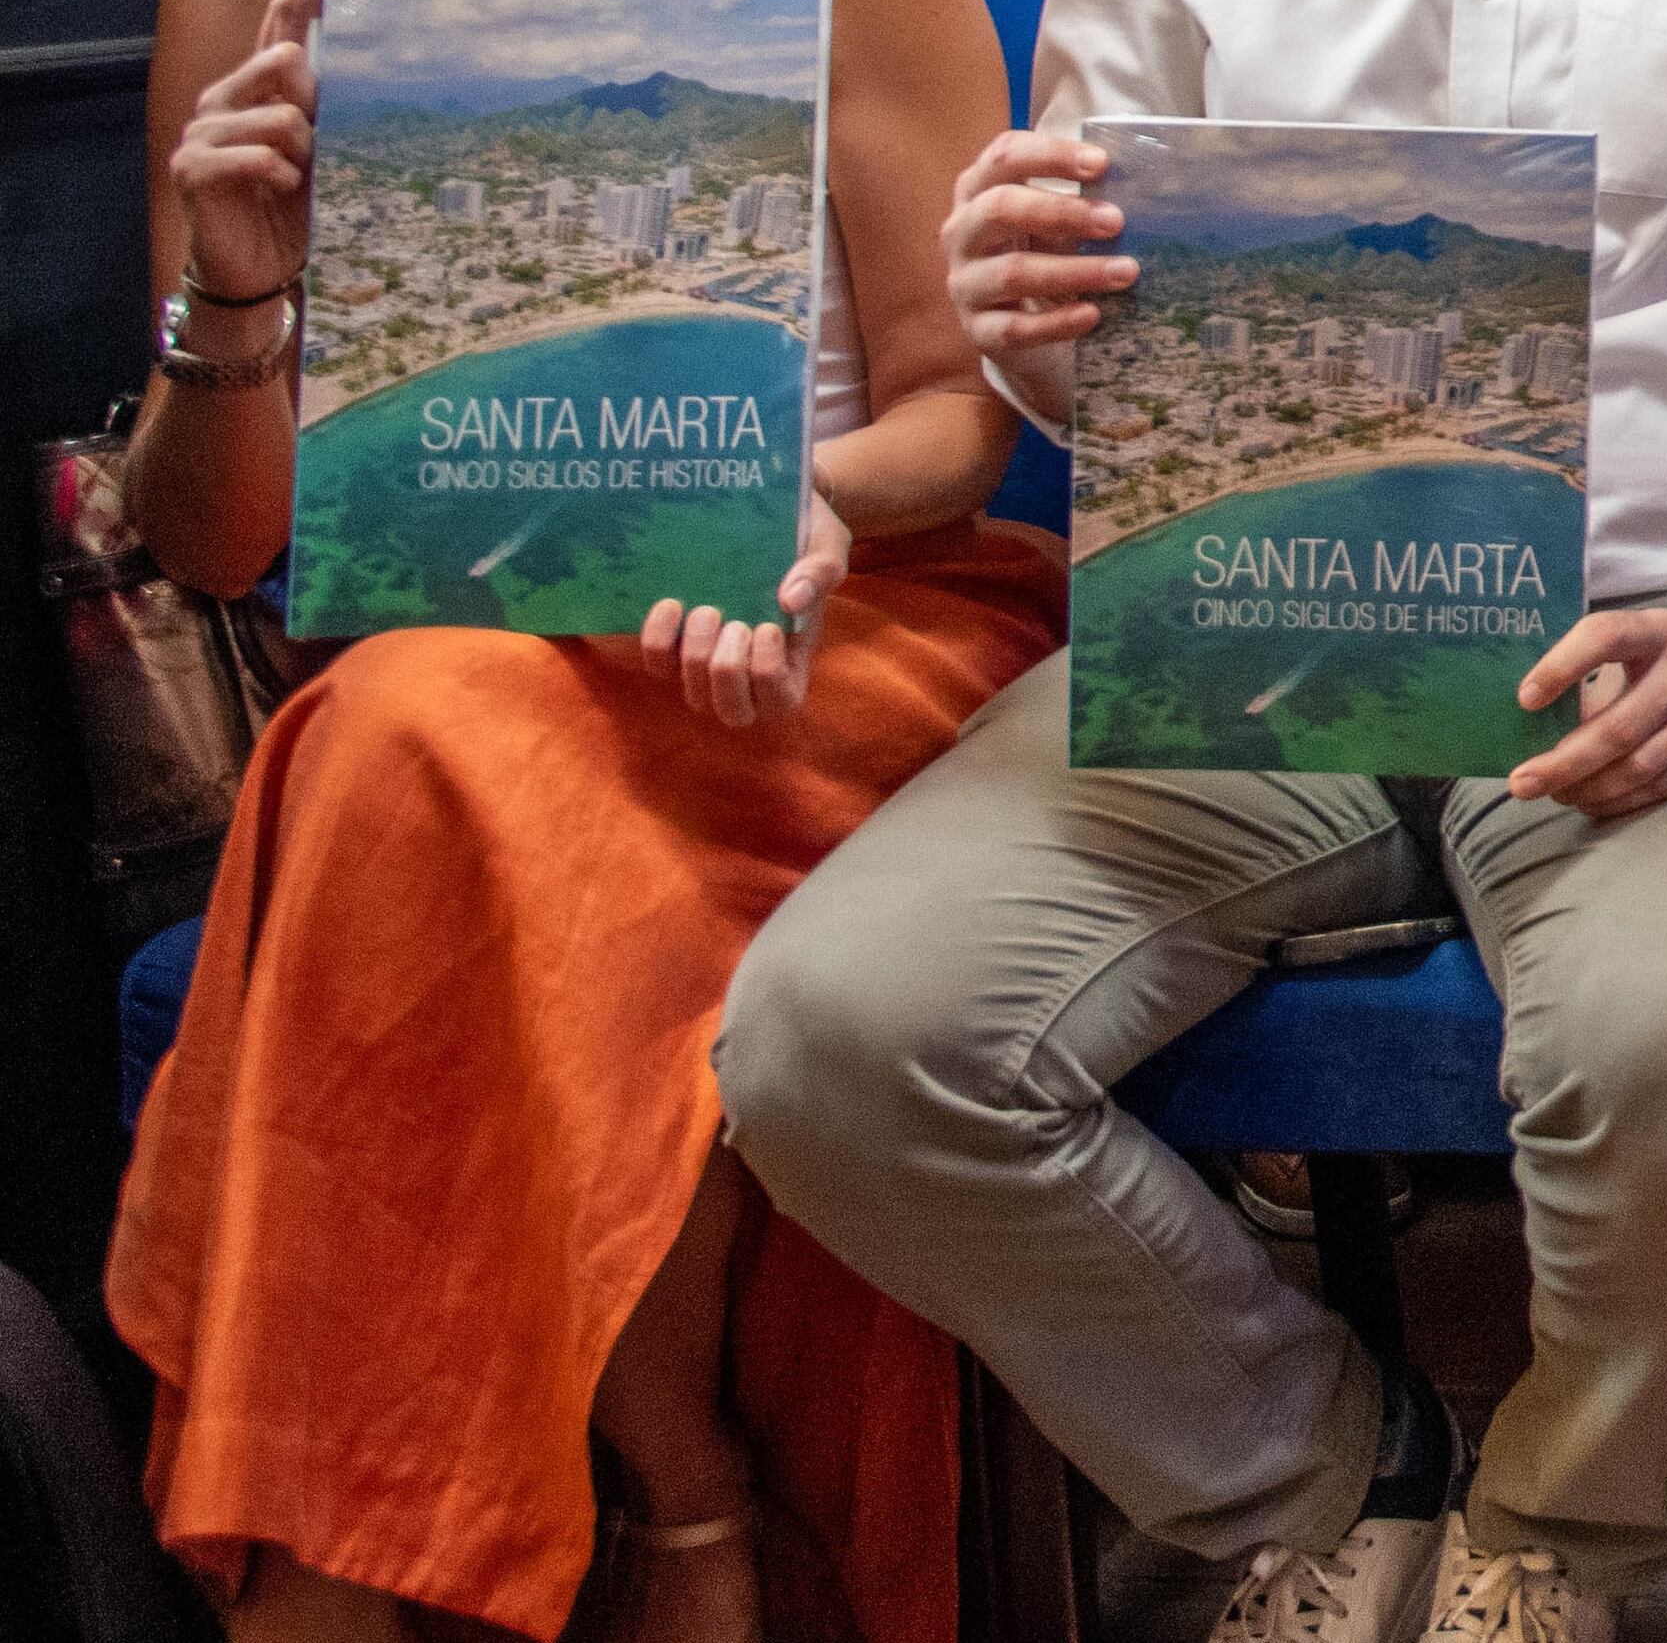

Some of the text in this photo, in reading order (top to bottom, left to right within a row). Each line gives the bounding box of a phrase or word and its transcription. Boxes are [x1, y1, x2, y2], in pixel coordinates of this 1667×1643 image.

[420, 395, 766, 452] SANTA MARTA
[418, 459, 764, 490] CINCO SIGLOS DE HISTORIA
[1193, 534, 1546, 598] SANTA MARTA
[1193, 598, 1545, 636] CINCO SIGLOS DE HISTORIA
